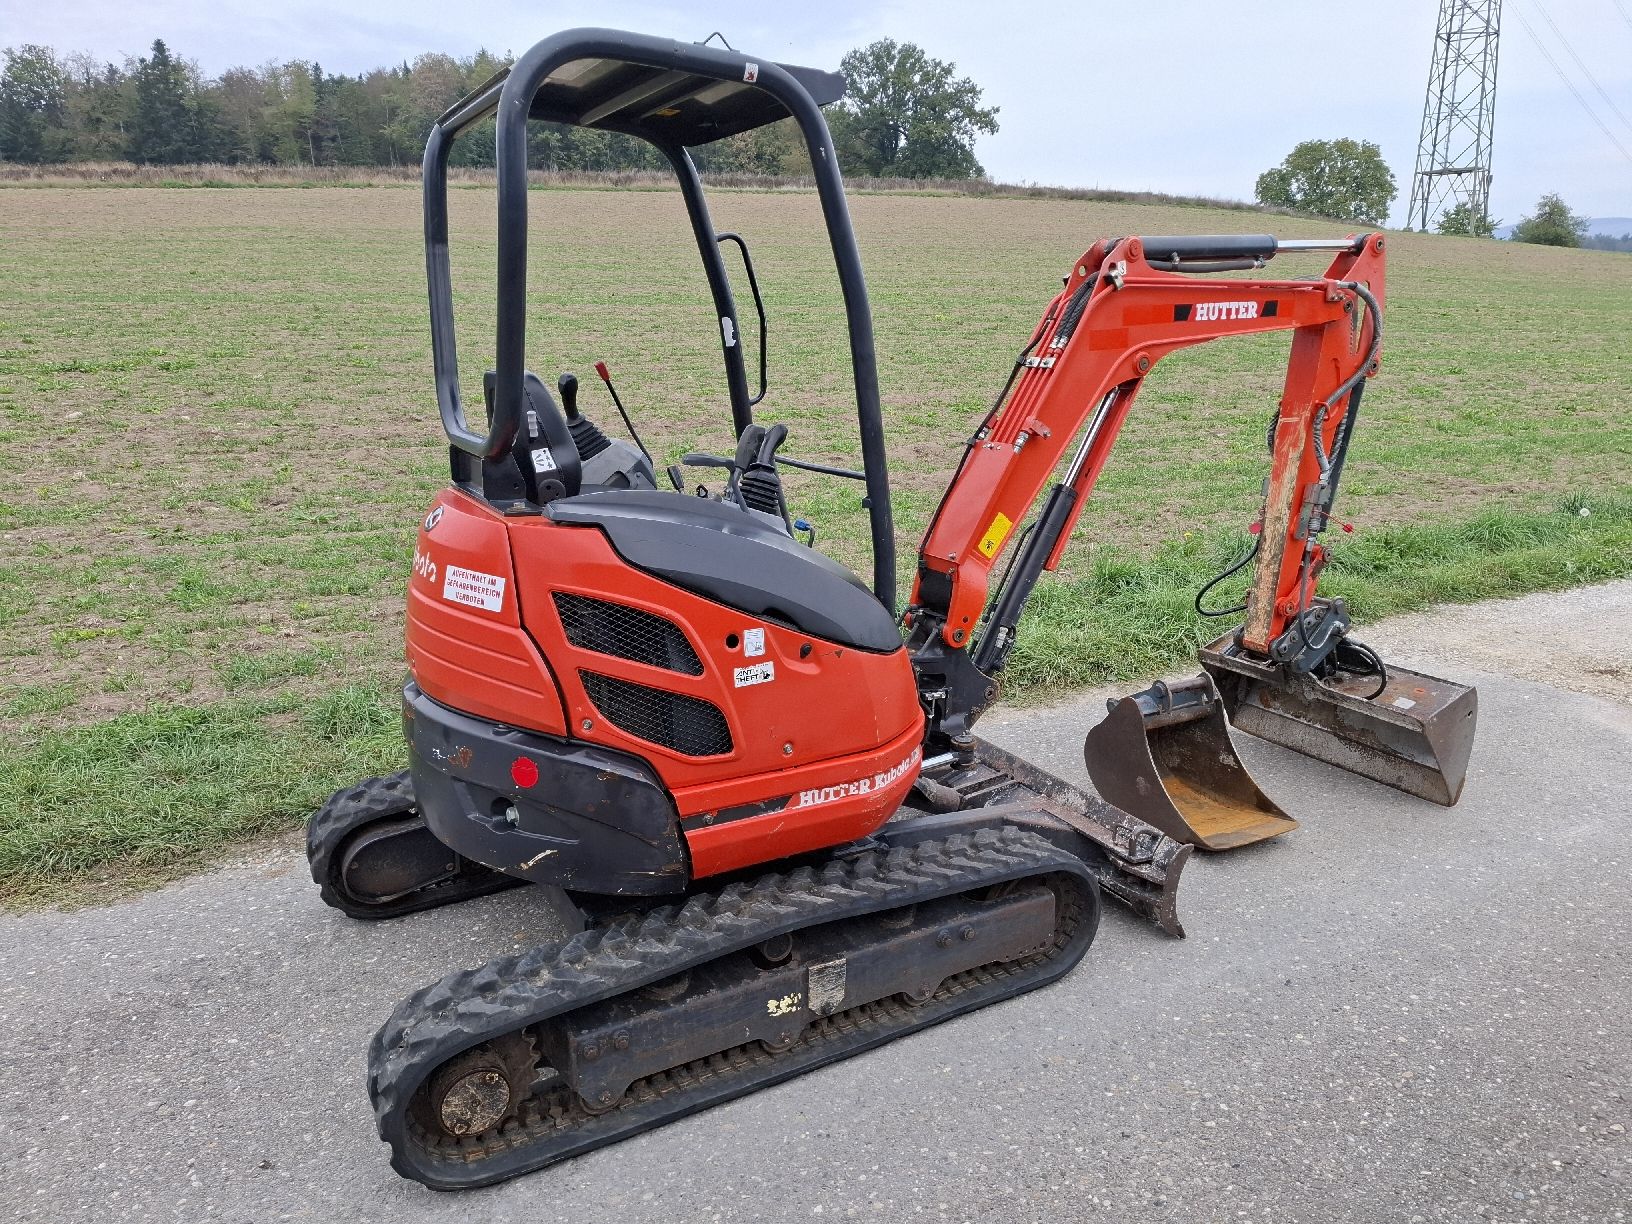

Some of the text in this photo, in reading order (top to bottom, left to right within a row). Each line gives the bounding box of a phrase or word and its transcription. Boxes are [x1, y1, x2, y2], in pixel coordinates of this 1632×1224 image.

[1195, 301, 1258, 321] HUTTER
[452, 569, 497, 587] AUFENTHALT IM
[446, 578, 501, 599] GEFAHRENBEREICH
[455, 591, 485, 606] VERBOTEN
[735, 673, 759, 683] THEFT
[799, 758, 910, 808] HUTTER Kubota
